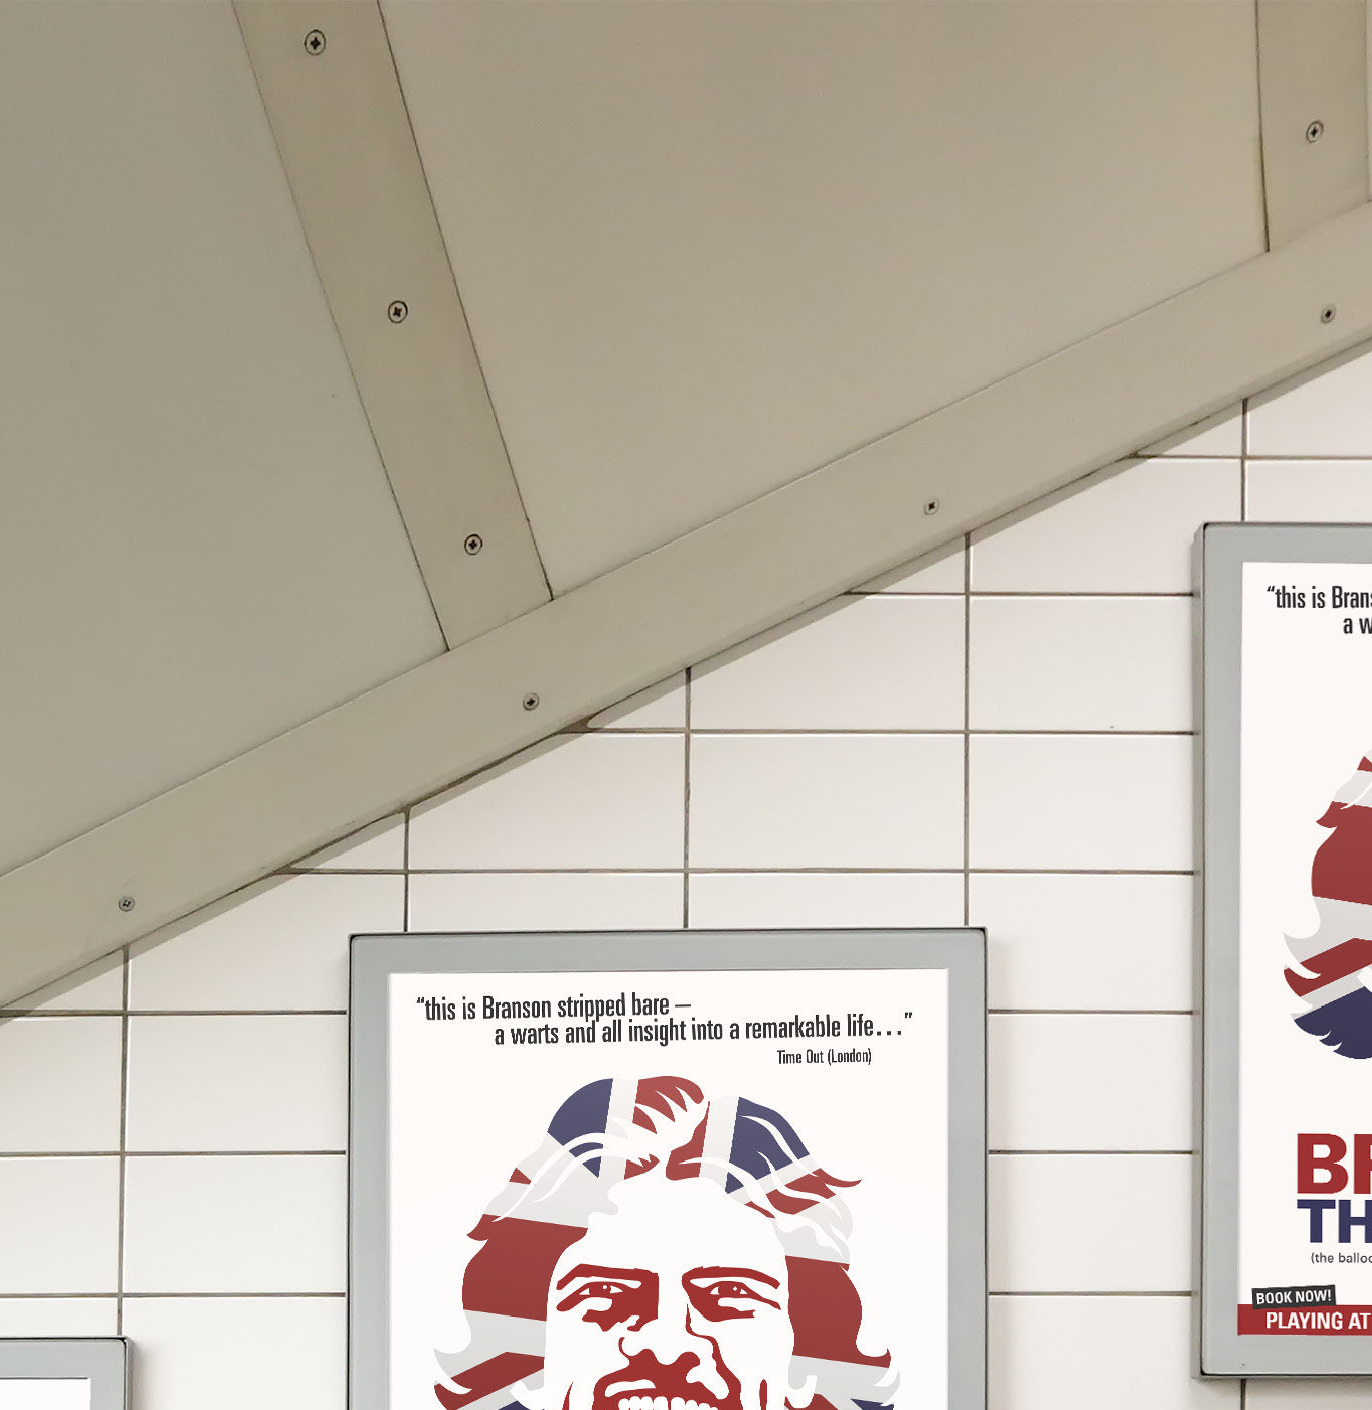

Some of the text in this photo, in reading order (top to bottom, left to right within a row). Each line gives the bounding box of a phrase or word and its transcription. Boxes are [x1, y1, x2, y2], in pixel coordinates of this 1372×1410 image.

[1311, 585, 1326, 609] is
[1343, 617, 1353, 635] a
[461, 995, 476, 1021] is
[482, 995, 552, 1020] Branson
[557, 991, 626, 1024] stripped
[631, 991, 670, 1016] bare
[494, 1028, 505, 1046] a
[510, 1023, 560, 1045] warts
[565, 1019, 596, 1044] and
[601, 1018, 622, 1043] all
[628, 1017, 687, 1047] insight
[691, 1016, 723, 1041] into
[729, 1022, 740, 1040] a
[745, 1013, 841, 1040] remarkable
[776, 1047, 872, 1067] Time Out (London)
[1255, 1289, 1332, 1305] BOOK NOW!
[1266, 1311, 1343, 1331] PLAYING
[1347, 1312, 1372, 1330] AT
